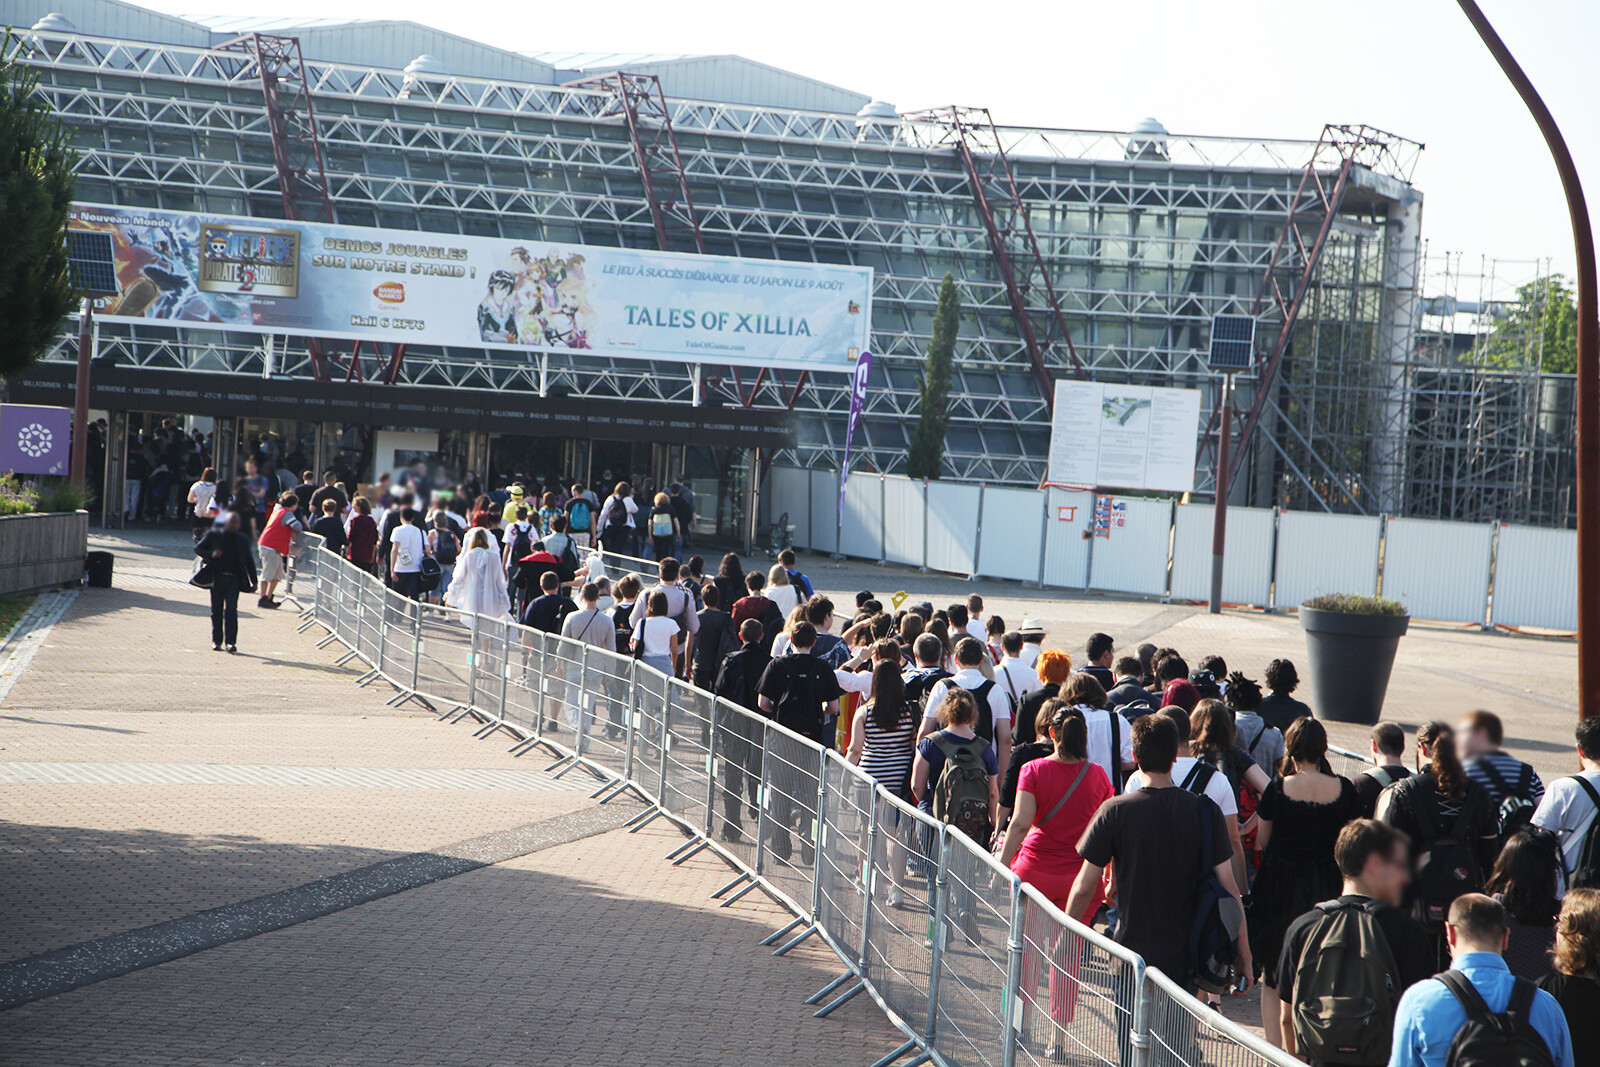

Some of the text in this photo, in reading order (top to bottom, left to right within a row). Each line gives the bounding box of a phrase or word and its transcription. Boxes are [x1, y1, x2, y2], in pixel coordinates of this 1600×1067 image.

[81, 212, 130, 225] Nouveau
[133, 216, 172, 228] Monde
[323, 237, 468, 261] DEMOS JOUABLES
[206, 262, 240, 282] PIRATE
[312, 254, 346, 269] SUR
[350, 258, 406, 273] NOTRE
[410, 262, 465, 277] STAND
[239, 271, 254, 291] 2
[602, 264, 616, 274] LE
[616, 265, 636, 276] JEU
[645, 267, 684, 279] SUCCÈS
[685, 270, 740, 283] DÉBARQUE
[743, 275, 760, 285] DU
[760, 276, 793, 288] JAPON
[794, 279, 806, 288] LE
[807, 281, 815, 289] 9
[815, 279, 845, 291] AOÛT
[351, 315, 377, 328] Hall
[380, 317, 390, 328] 6
[624, 305, 812, 337] TALES OF XILLIA
[22, 380, 61, 389] WILLKOMMEN
[133, 387, 160, 396] WELCOME
